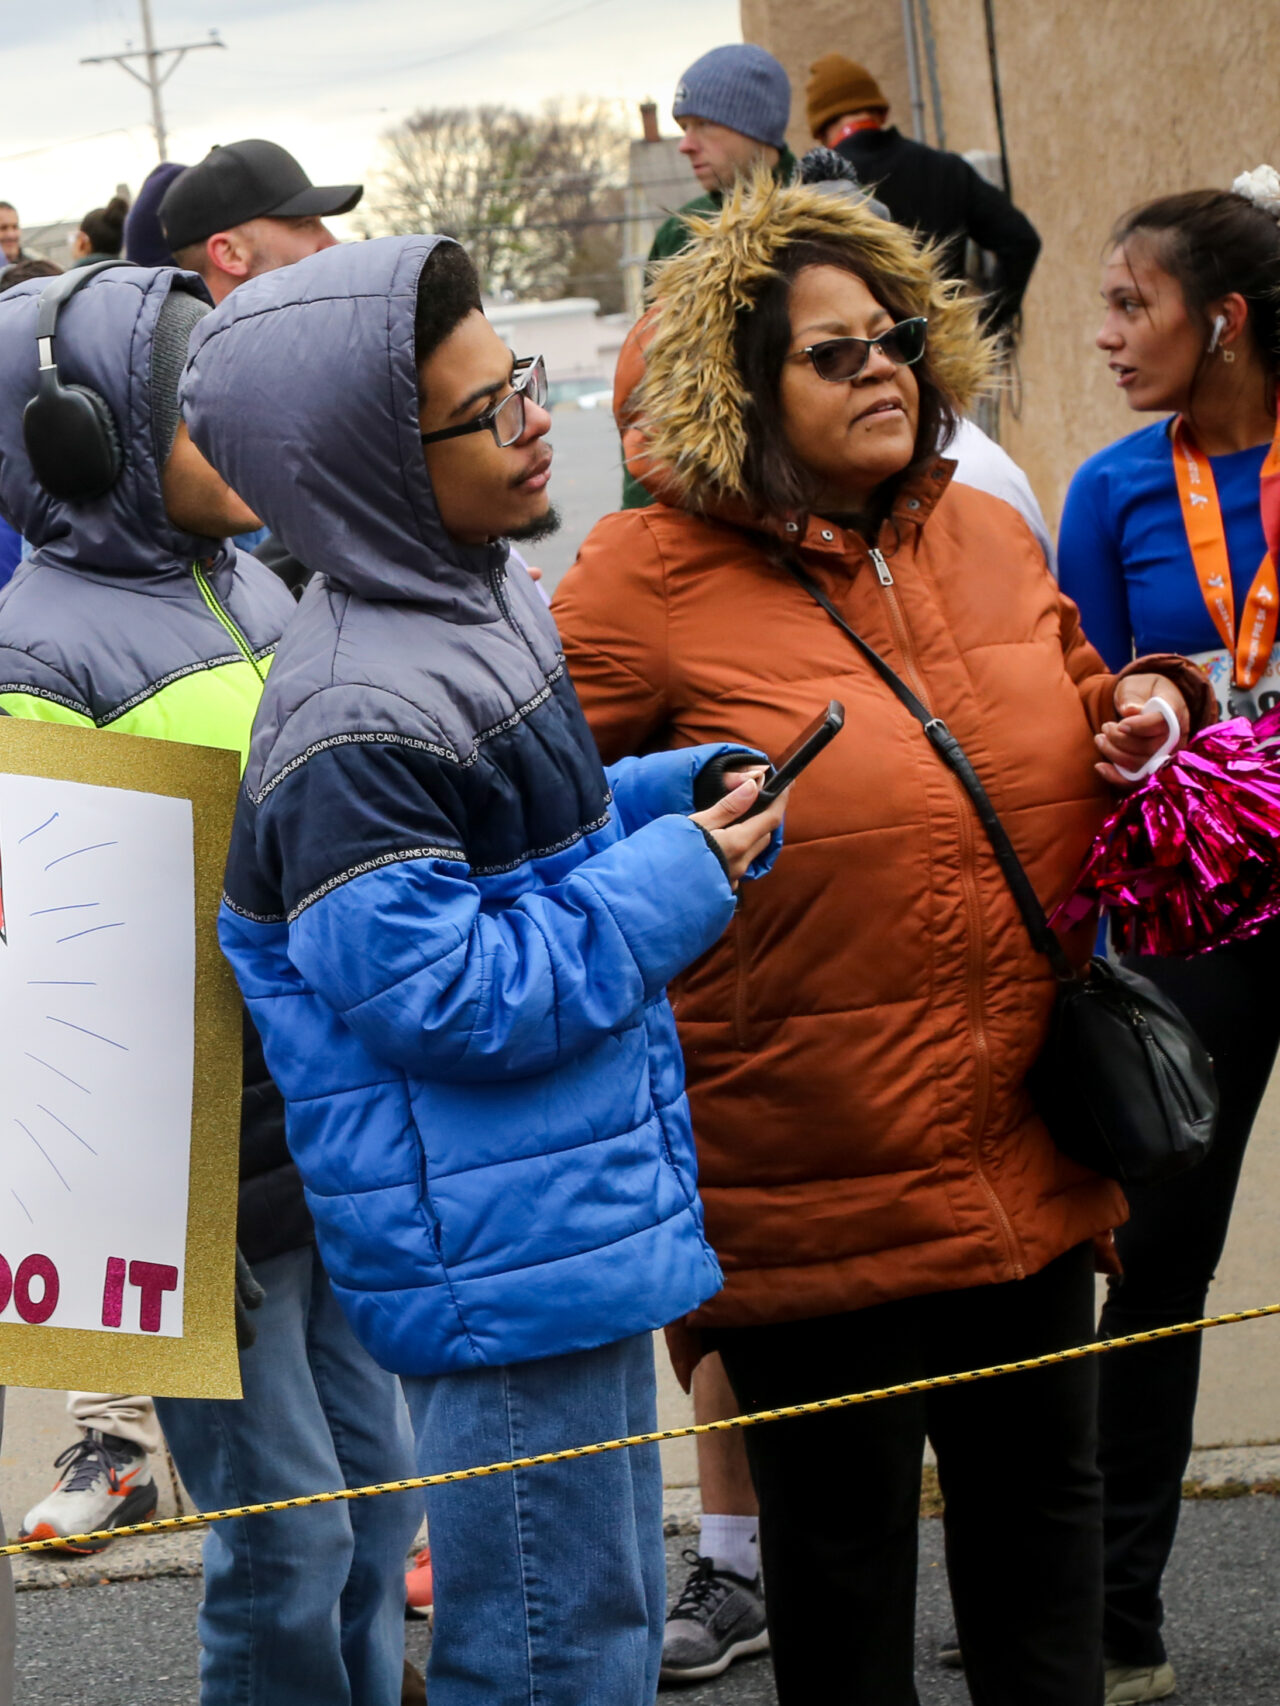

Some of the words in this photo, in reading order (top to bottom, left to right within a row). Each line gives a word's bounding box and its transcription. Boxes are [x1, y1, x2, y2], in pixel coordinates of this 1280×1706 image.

[376, 733, 404, 745] CALVIN
[347, 859, 376, 877] CALVIN
[374, 853, 398, 866] KLEIN
[101, 1256, 179, 1332] IT
